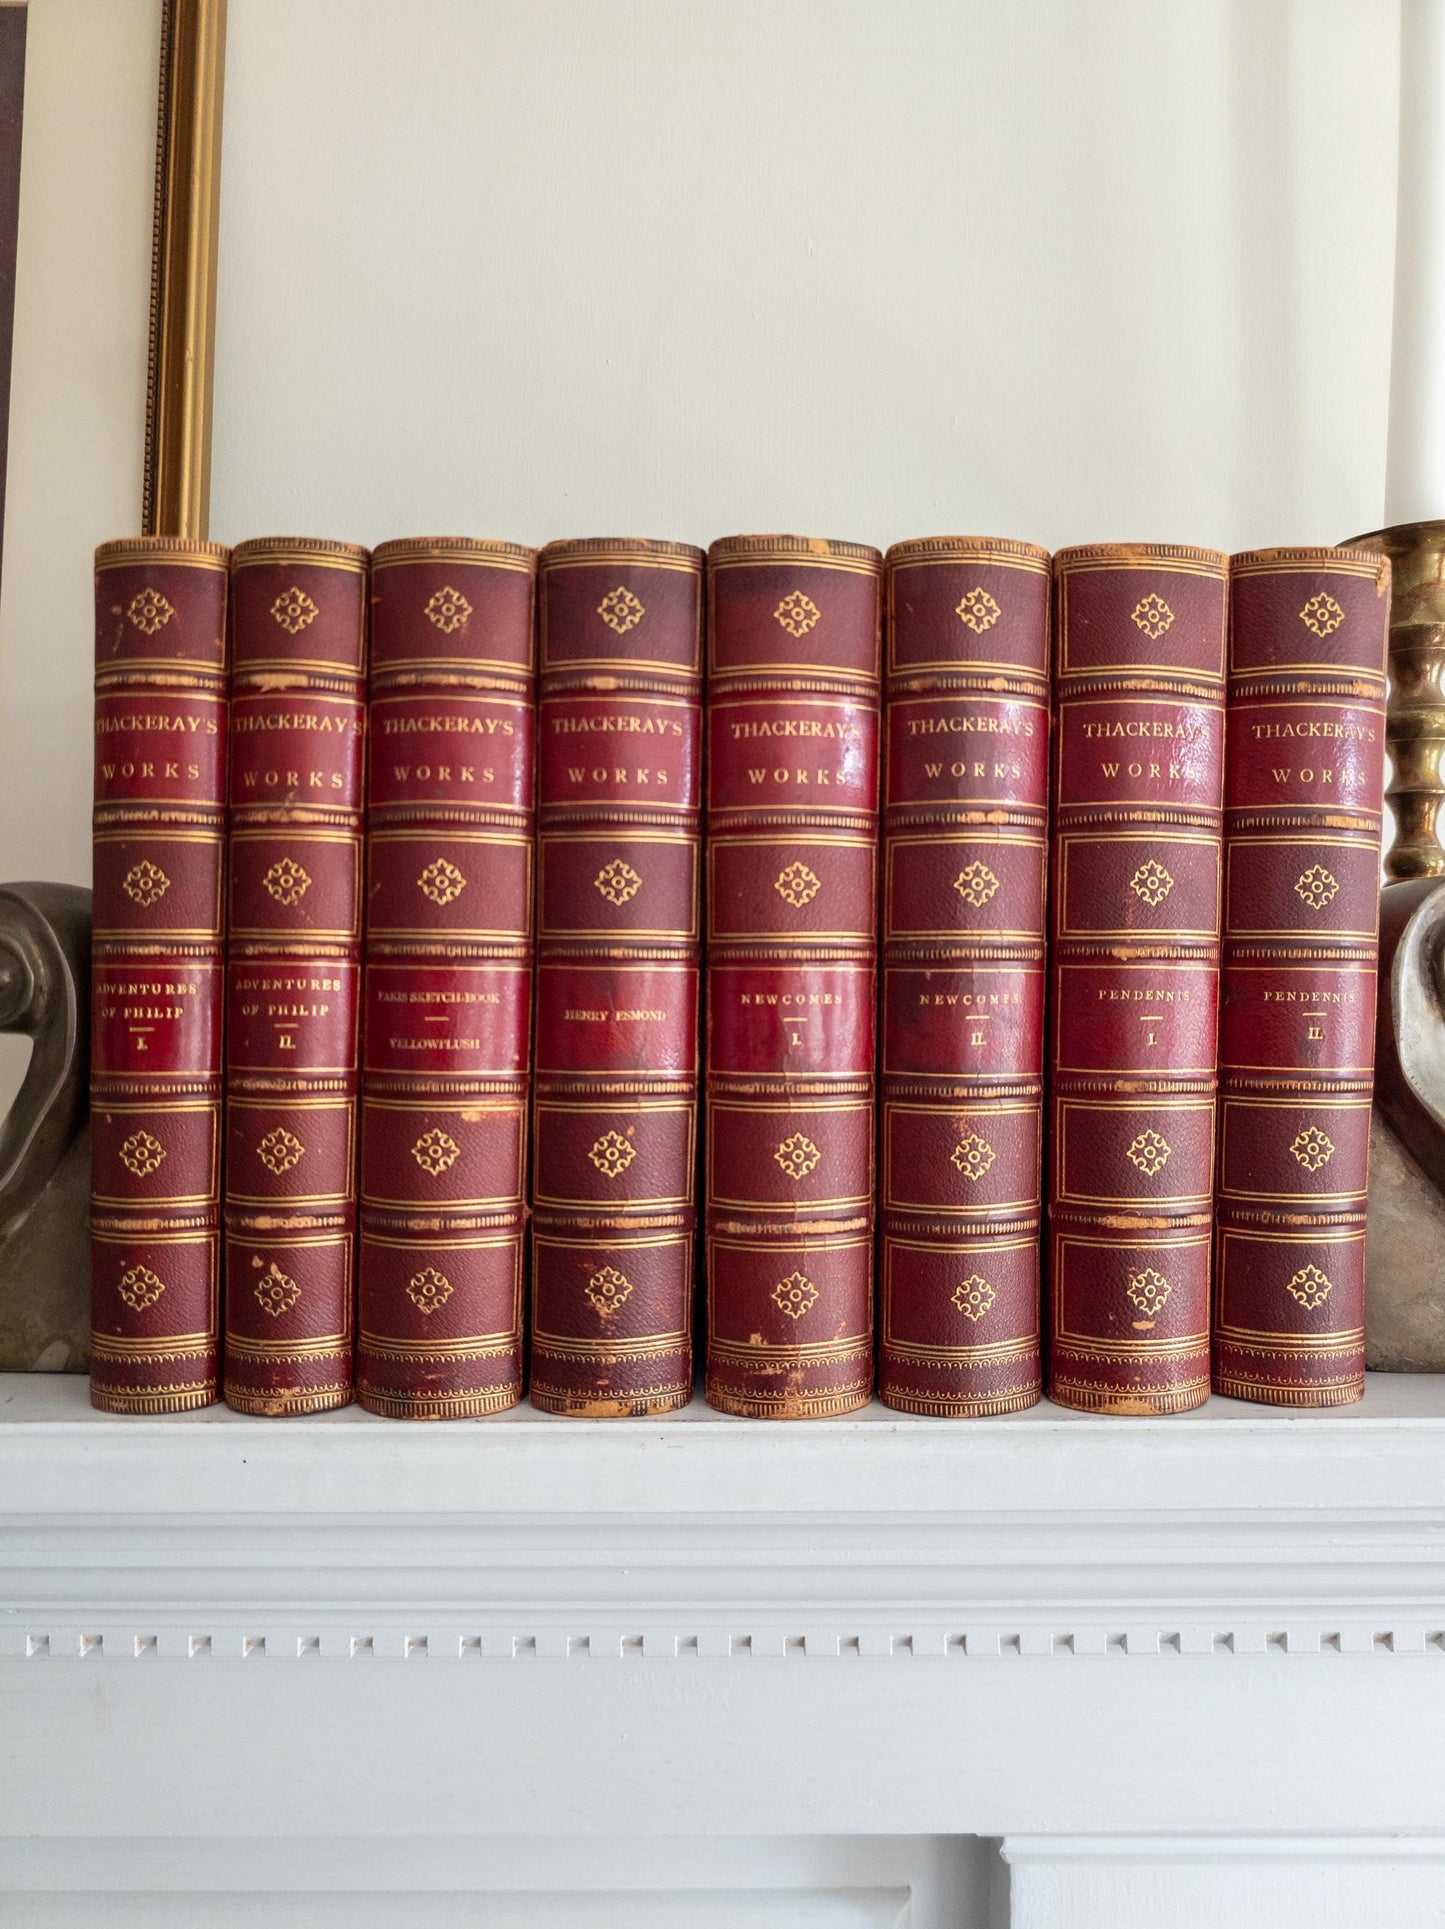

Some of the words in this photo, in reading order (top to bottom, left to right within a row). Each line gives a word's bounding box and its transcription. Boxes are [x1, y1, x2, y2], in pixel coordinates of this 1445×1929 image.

[235, 713, 363, 736] THACKERAYS
[383, 716, 514, 736] THACKERAY'S
[552, 716, 683, 737] THACKERAY'S
[907, 717, 1034, 738] THACKERAY'S
[102, 762, 200, 781] WORKS
[393, 765, 496, 784] WORKS
[568, 767, 669, 785] WORKS
[747, 769, 848, 786] WORKS
[924, 762, 1021, 779] WORKS
[1102, 763, 1196, 780] WORKS
[1271, 768, 1366, 786] WORKS
[243, 771, 343, 789] WORKS
[96, 983, 198, 996] ADVENTURES
[235, 979, 342, 993] ADVENTURES
[741, 994, 843, 1006] NEWCOMES
[919, 993, 1021, 1006] NEWCOMES
[1098, 989, 1191, 1002] PENDENNIS
[1263, 991, 1356, 1004] PENDENNIS
[102, 1007, 117, 1019] OF
[124, 1007, 184, 1019] PHILIP
[242, 1004, 259, 1016] OF
[268, 1003, 329, 1017] PHILIP
[564, 1010, 608, 1022] HENRY
[615, 1009, 668, 1022] ESMOND
